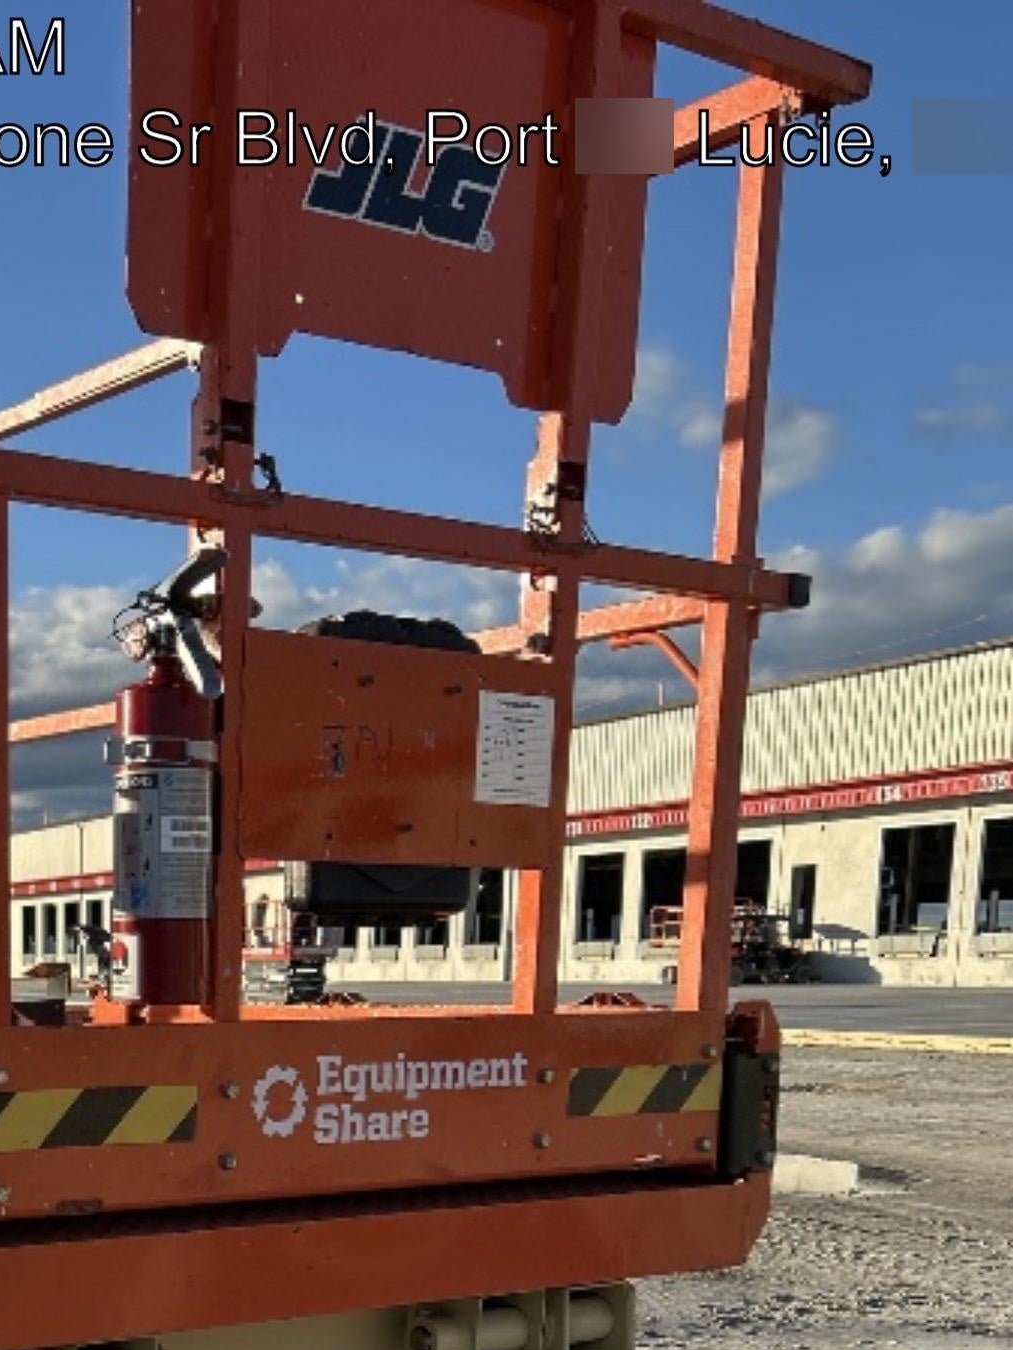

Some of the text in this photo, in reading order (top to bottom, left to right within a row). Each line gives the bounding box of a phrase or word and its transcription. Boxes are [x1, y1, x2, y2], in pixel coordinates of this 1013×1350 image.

[301, 114, 509, 252] JLG
[316, 1052, 528, 1101] Equipment
[315, 1104, 429, 1144] Share
